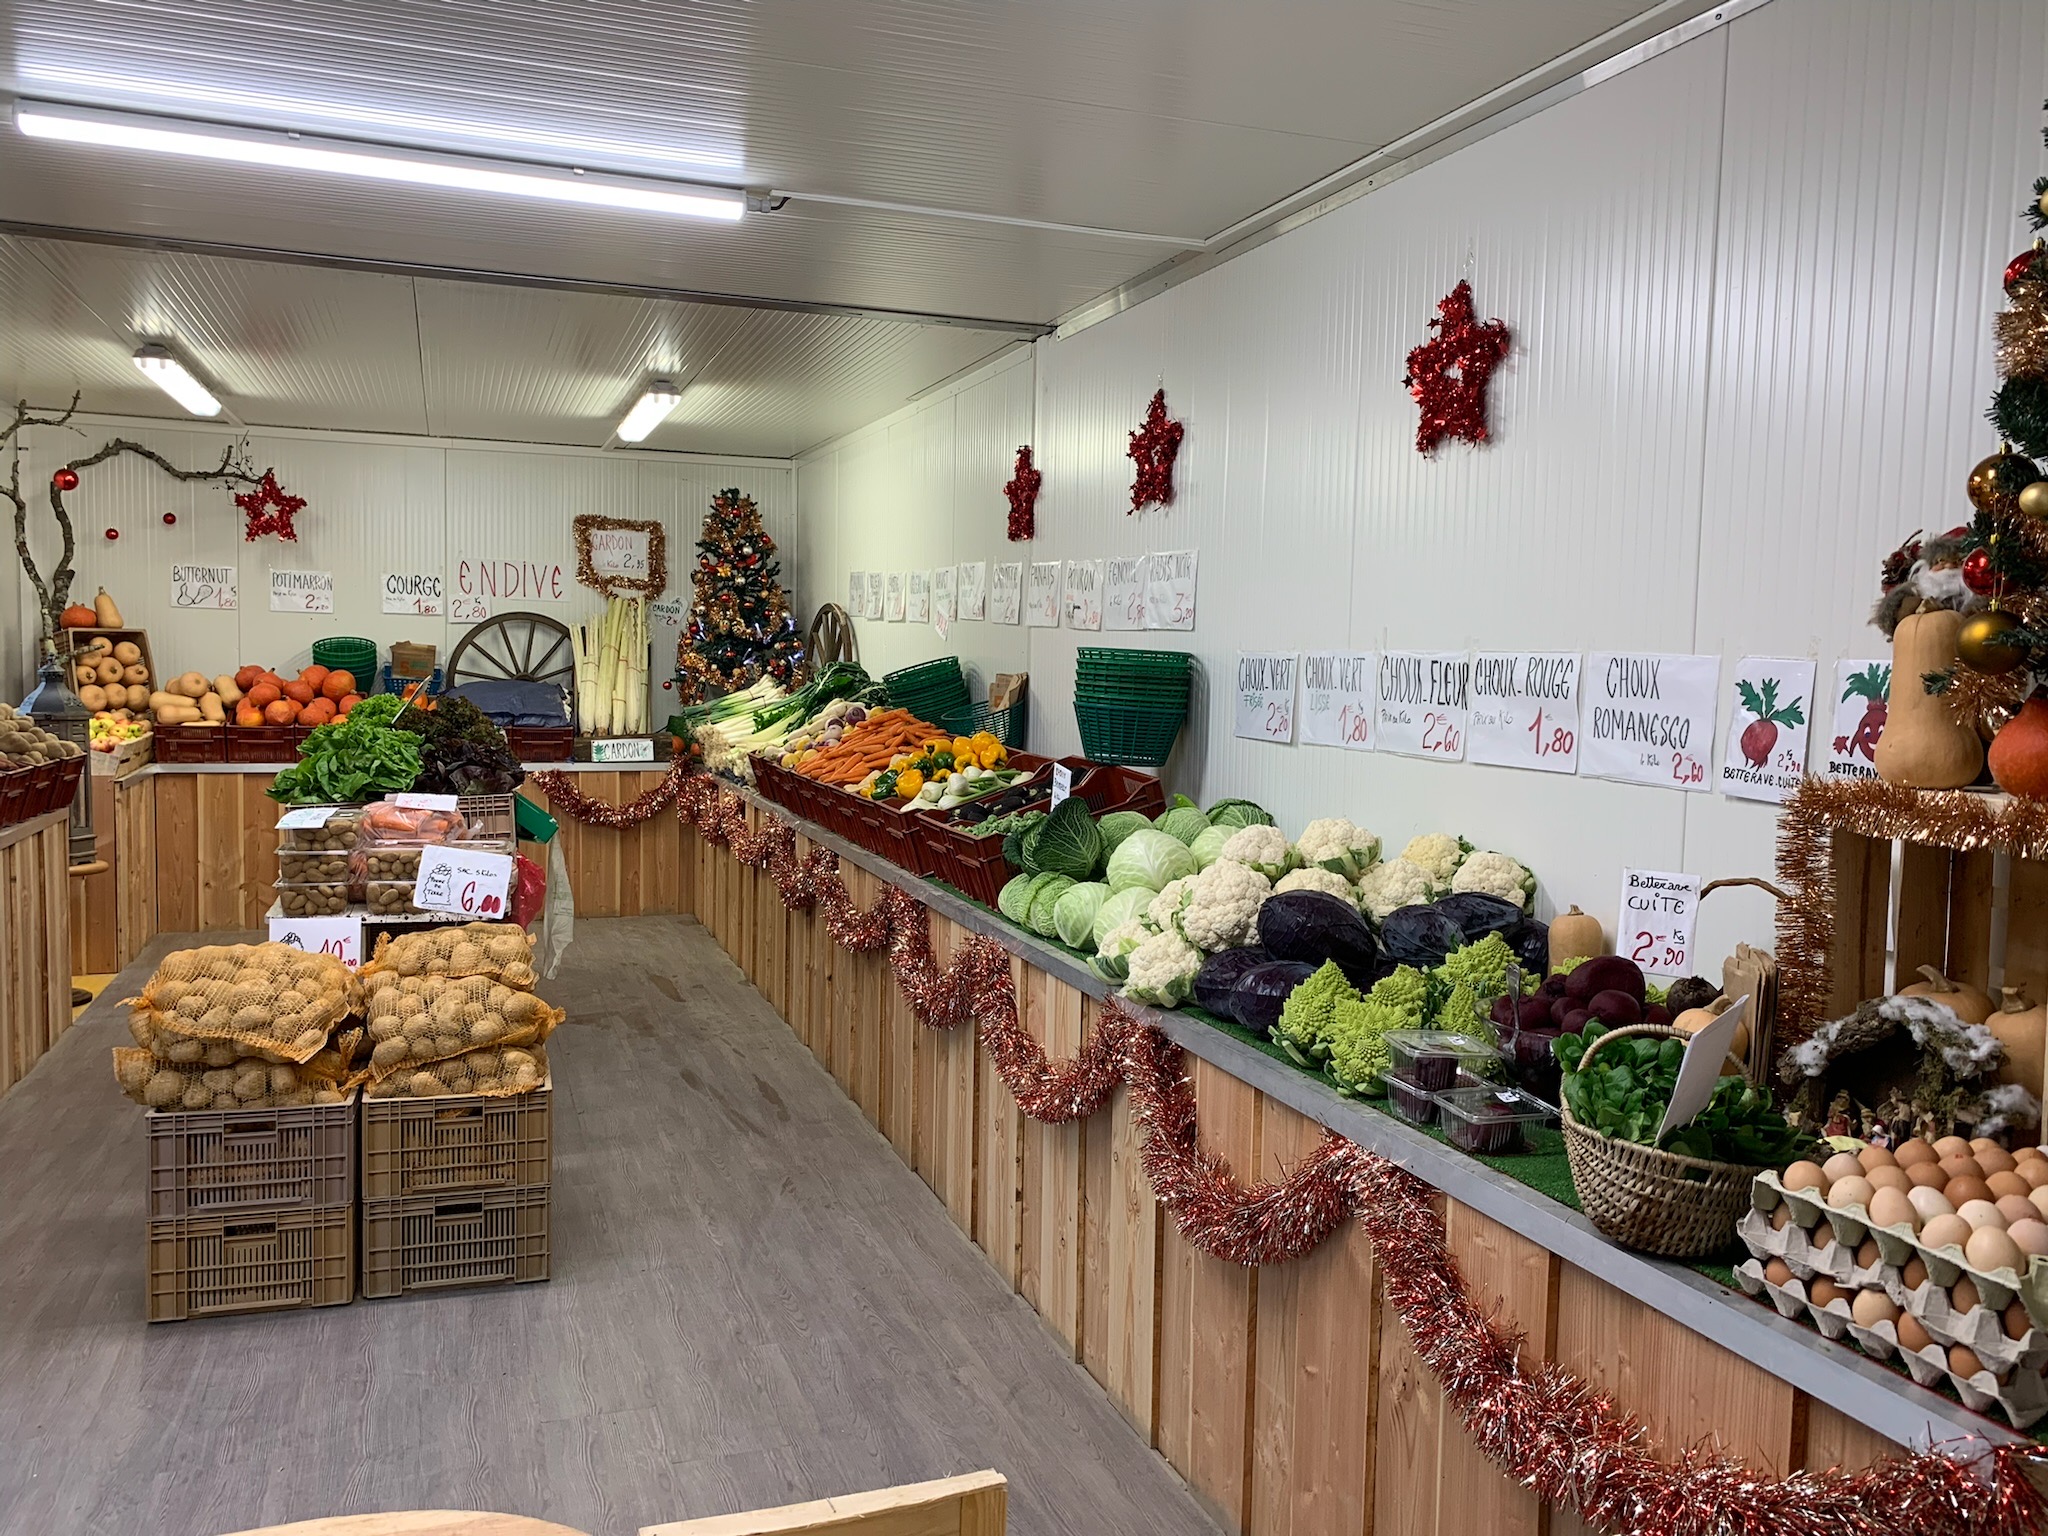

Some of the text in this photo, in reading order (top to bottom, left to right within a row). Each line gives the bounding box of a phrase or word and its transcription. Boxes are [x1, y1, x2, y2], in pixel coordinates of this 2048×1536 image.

[592, 534, 633, 556] CARDON
[173, 565, 232, 584] BUTTERNUT
[272, 571, 333, 591] POTIMARRON
[386, 574, 441, 598] COURGE
[460, 560, 562, 599] ENDIVE
[452, 599, 487, 620] 2,80
[652, 604, 681, 614] CARDON
[1606, 657, 1661, 700] CHOUX
[1338, 704, 1368, 744] 1,80
[1422, 712, 1460, 752] 2,60
[1528, 706, 1574, 757] 1,80
[1593, 706, 1690, 750] ROMANESCO
[604, 742, 641, 760] CARDON
[1672, 752, 1704, 784] 2,60
[1628, 874, 1692, 892] Betterave
[461, 881, 501, 914] 6,00
[1628, 892, 1685, 914] CUITE
[1632, 931, 1685, 968] 2,90
